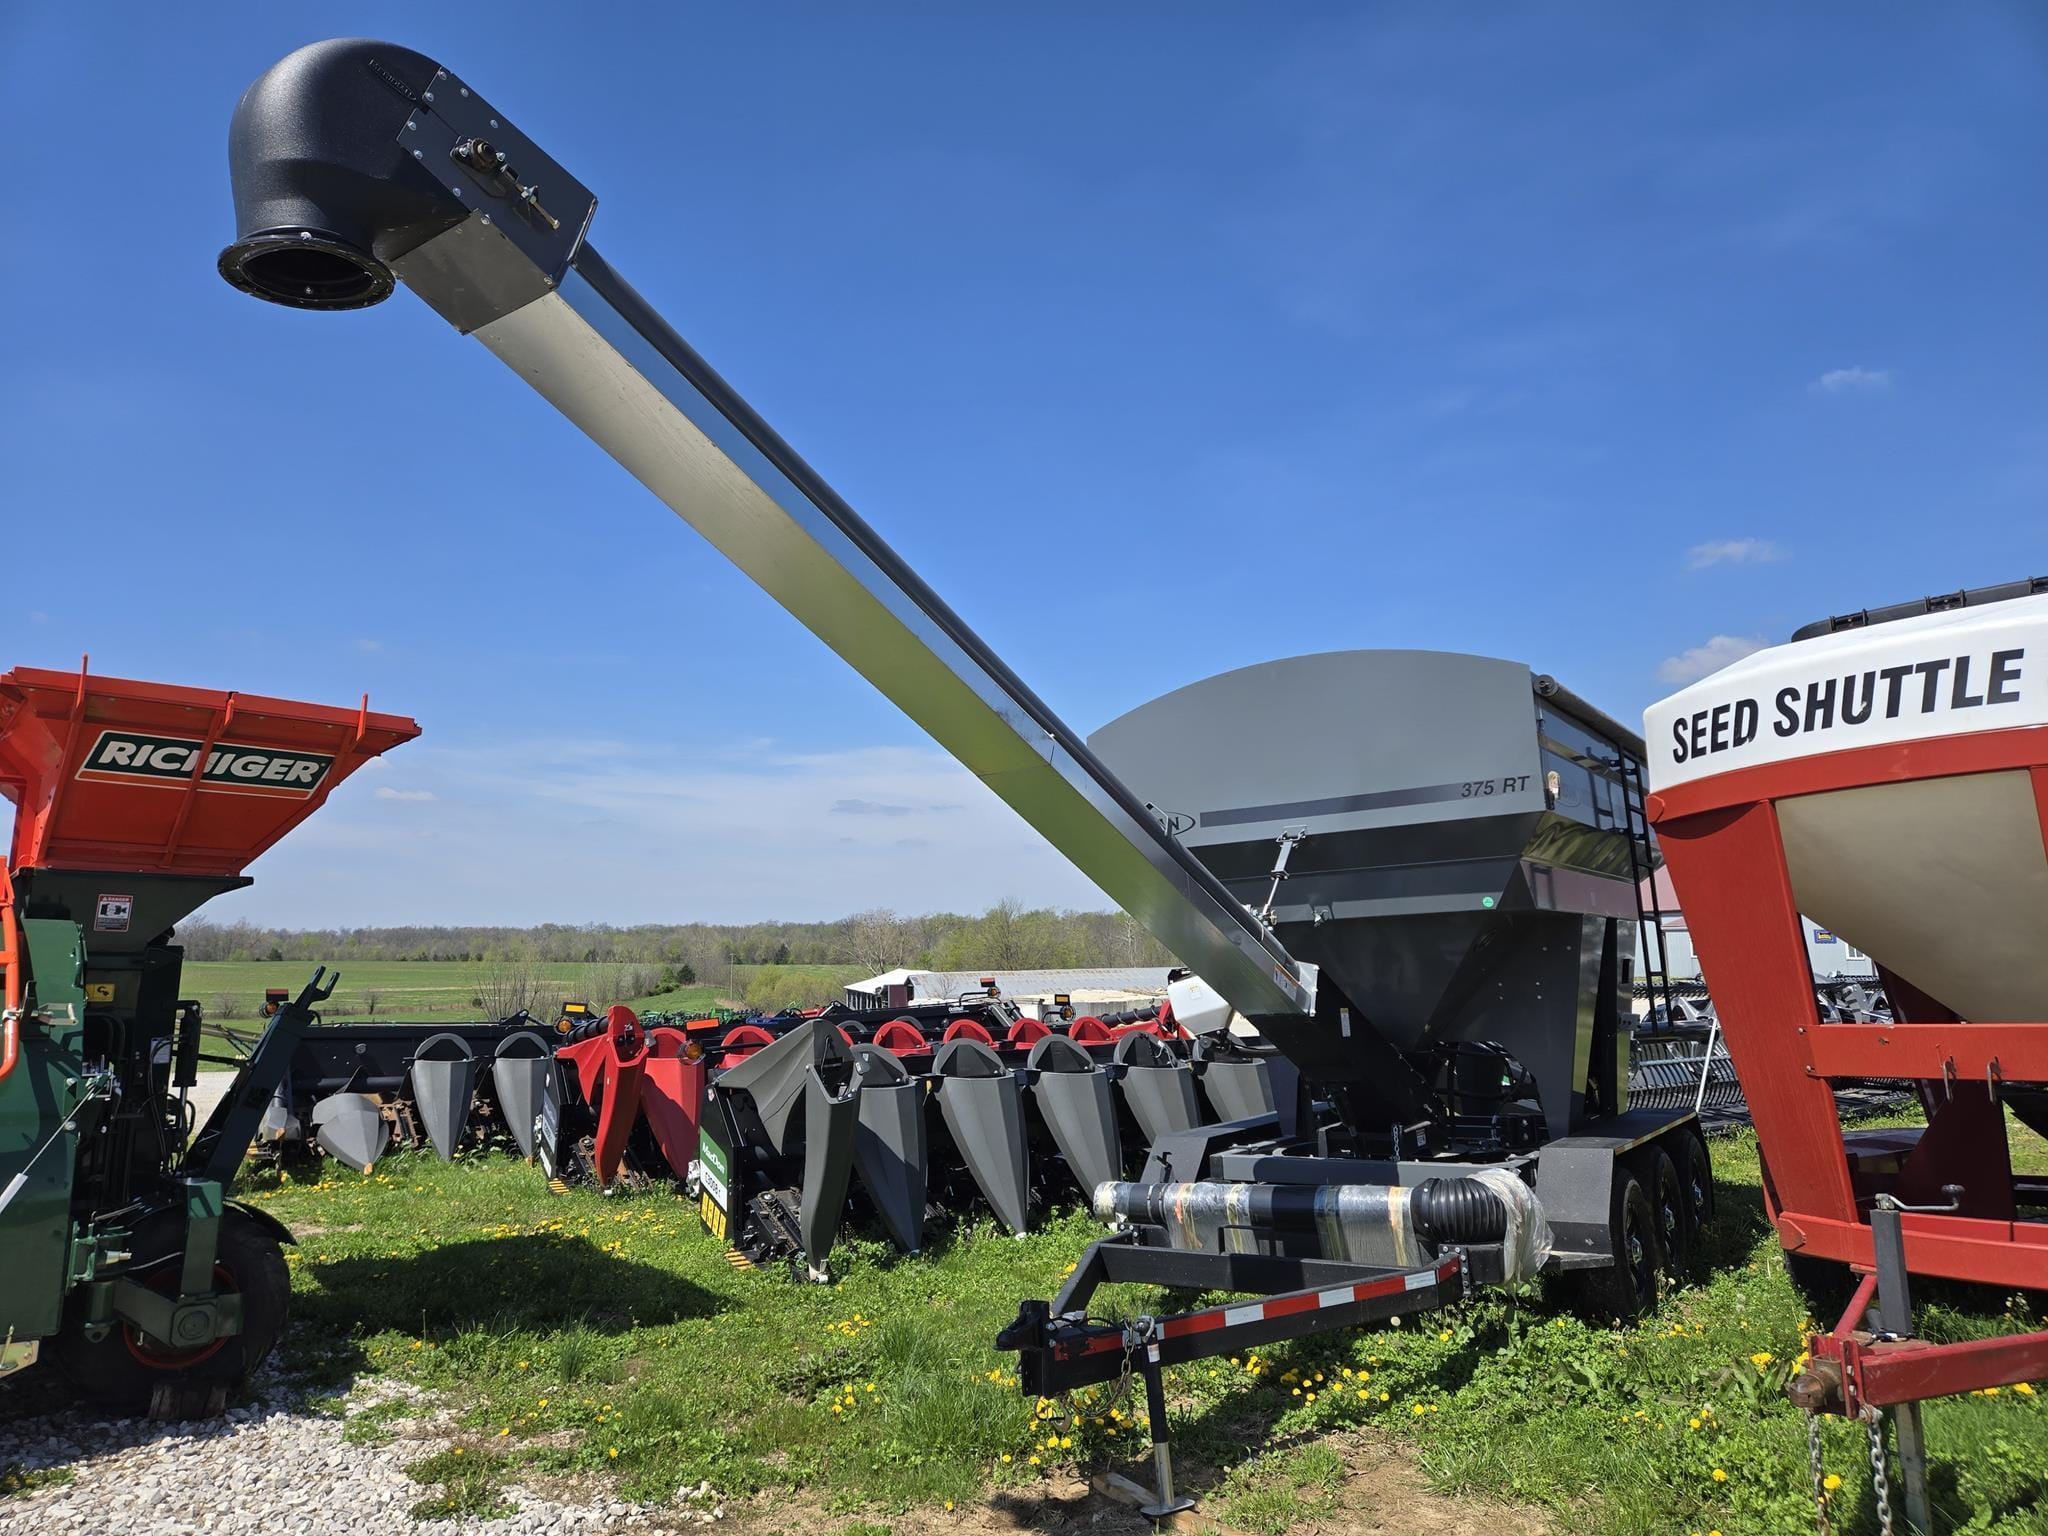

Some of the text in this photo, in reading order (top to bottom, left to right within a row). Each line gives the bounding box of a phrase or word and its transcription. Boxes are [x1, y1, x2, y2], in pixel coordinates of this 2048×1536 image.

[1673, 648, 2025, 764] SEED SHUTTLE
[98, 740, 319, 783] RICHIGER
[1461, 775, 1530, 798] 375 RT
[702, 1142, 725, 1175] MacDon
